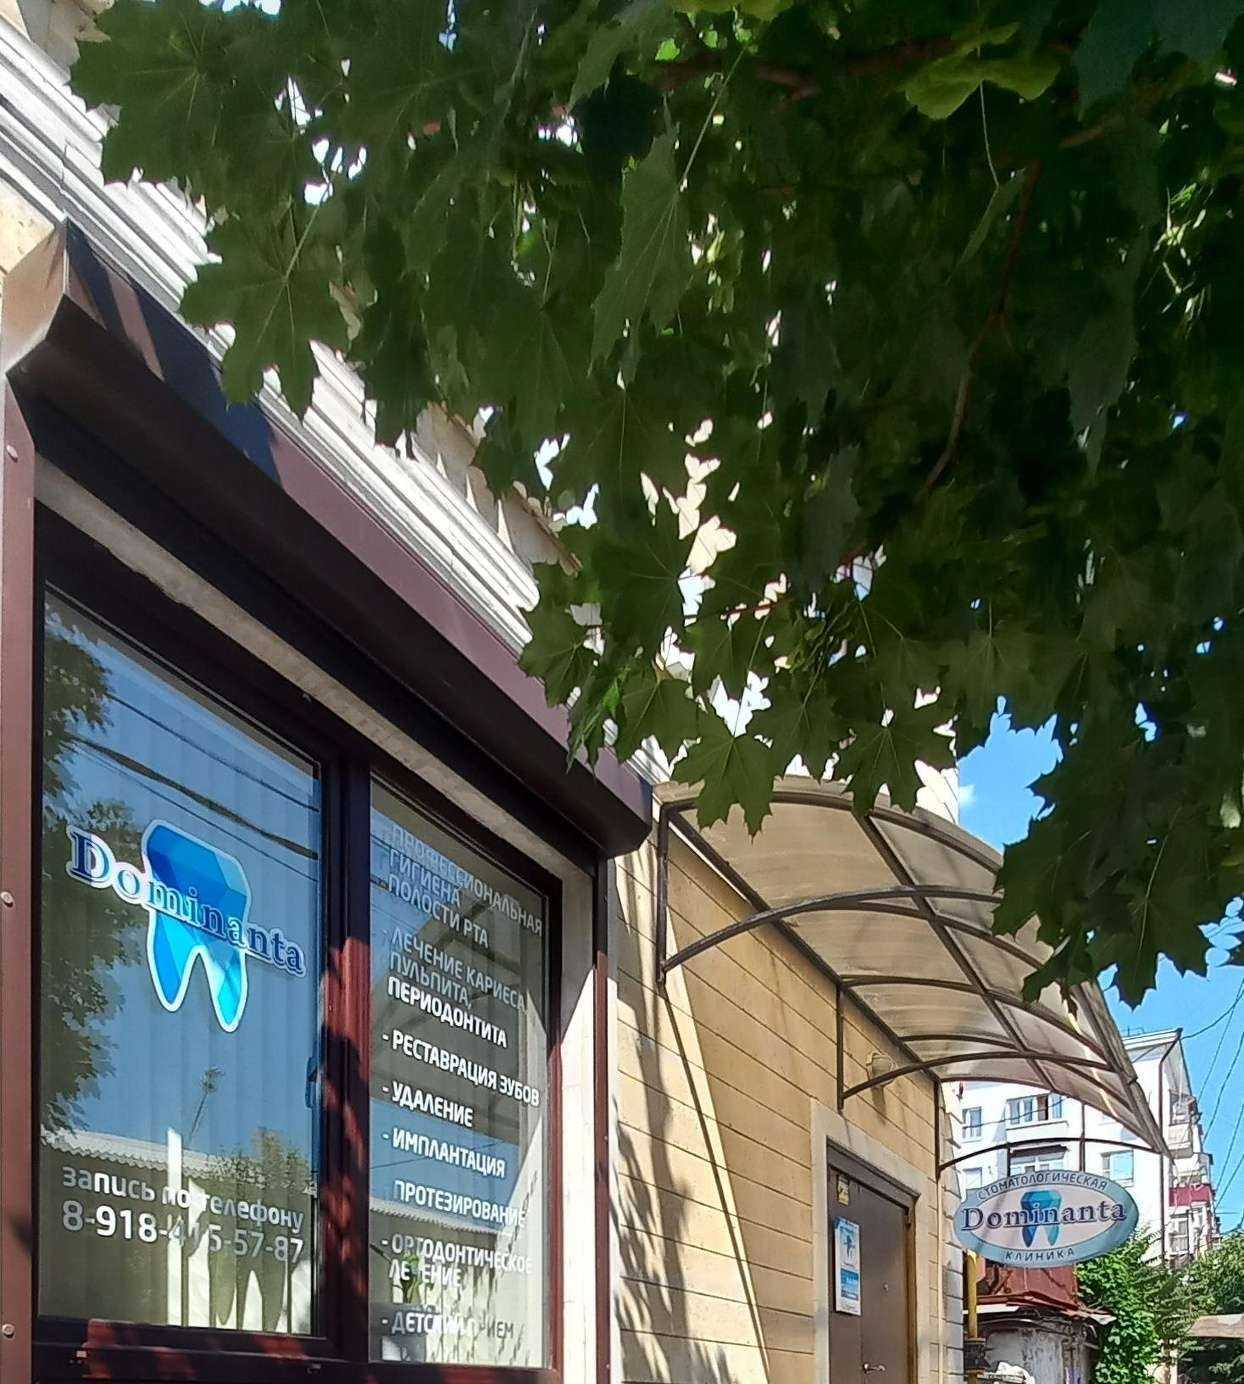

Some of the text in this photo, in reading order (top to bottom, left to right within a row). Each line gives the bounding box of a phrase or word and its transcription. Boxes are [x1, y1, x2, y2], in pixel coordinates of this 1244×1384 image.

[66, 825, 308, 978] Dominanta
[389, 849, 462, 908] ГИГИЕНА
[388, 874, 489, 949] ПОЛОСТИ РТА
[391, 927, 463, 980] ЛЕЧЕНИЕ
[388, 976, 508, 1049] ПЕРИОДОНТИТА
[392, 1029, 540, 1107] РЕСТАВРАЦИЯ ЗУБОВ
[392, 1081, 474, 1128] УДАЛЕНИЕ
[392, 1127, 506, 1179] ИМПЛАНТАЦИЯ
[62, 1166, 304, 1234] запись по телефону
[393, 1179, 526, 1228] ПРОТЕЗИРОВАНИЕ
[977, 1172, 1108, 1201] СТОМАТОЛОГИЧЕСКАЯ
[961, 1201, 1127, 1231] Dominanta
[391, 1233, 532, 1274] ОРТОДОНТИЧЕСКОЕ
[1004, 1247, 1075, 1262] КЛИНИКА
